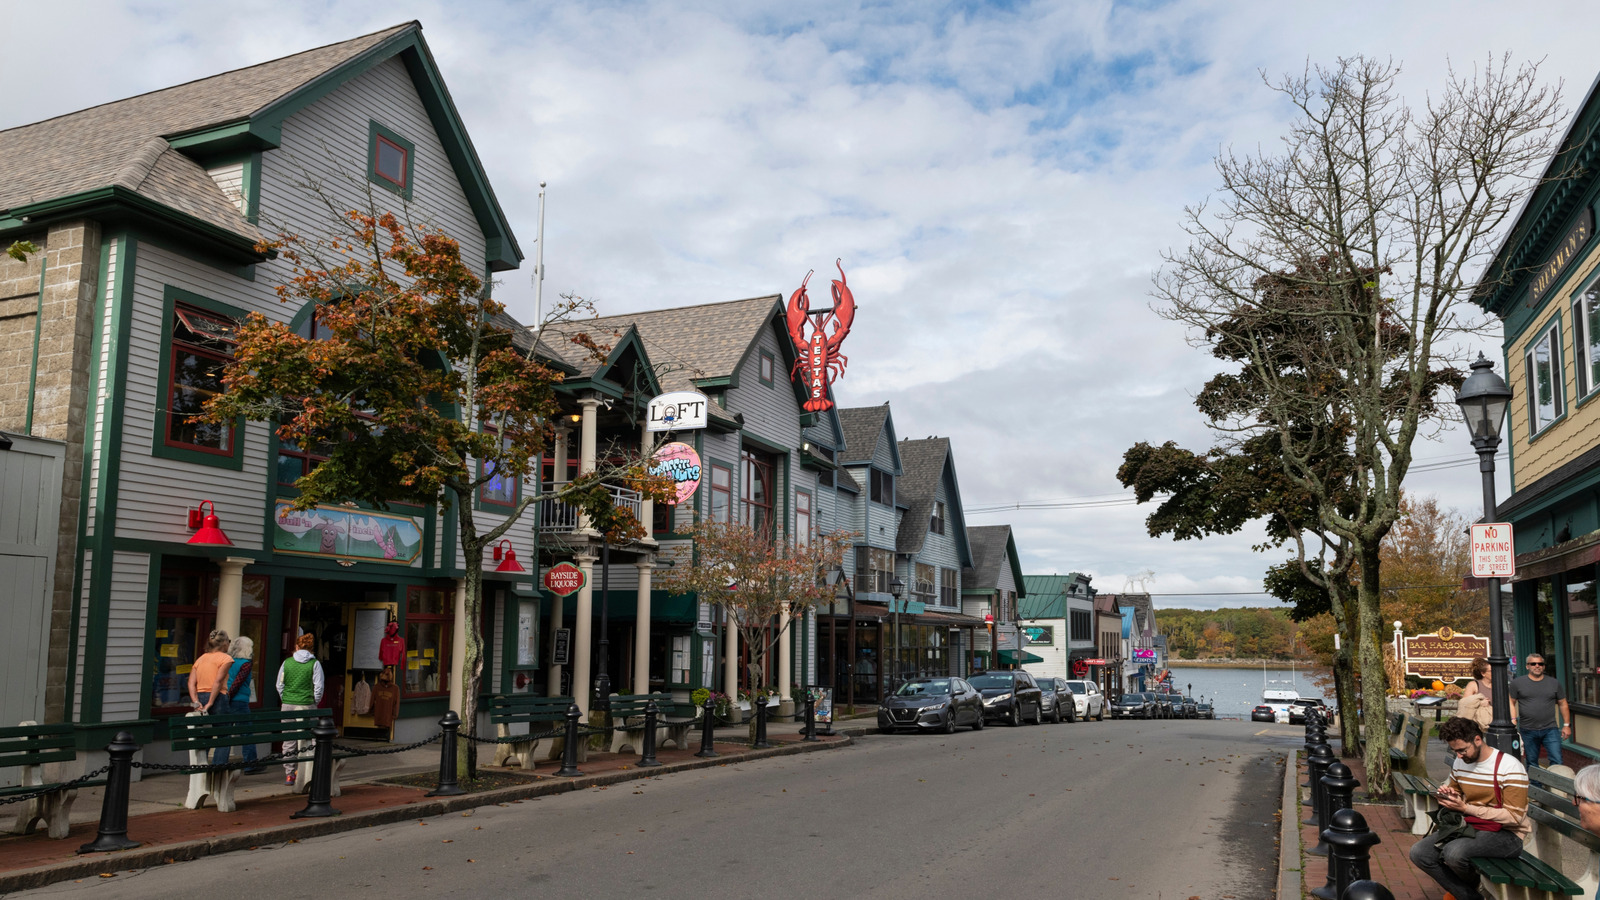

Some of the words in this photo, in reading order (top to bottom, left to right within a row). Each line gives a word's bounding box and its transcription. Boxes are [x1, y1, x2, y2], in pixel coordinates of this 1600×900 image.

[1533, 221, 1586, 299] SHERMAN'S
[651, 401, 705, 422] LOFT
[350, 525, 374, 536] inch
[1485, 529, 1497, 538] NO
[1475, 542, 1509, 552] PARKING
[1489, 563, 1508, 571] STREET
[550, 571, 579, 580] BAYSIDE
[550, 580, 578, 588] LIQUORS
[1409, 641, 1428, 650] BAR
[1429, 641, 1467, 650] HARBOR
[1468, 641, 1485, 649] INN
